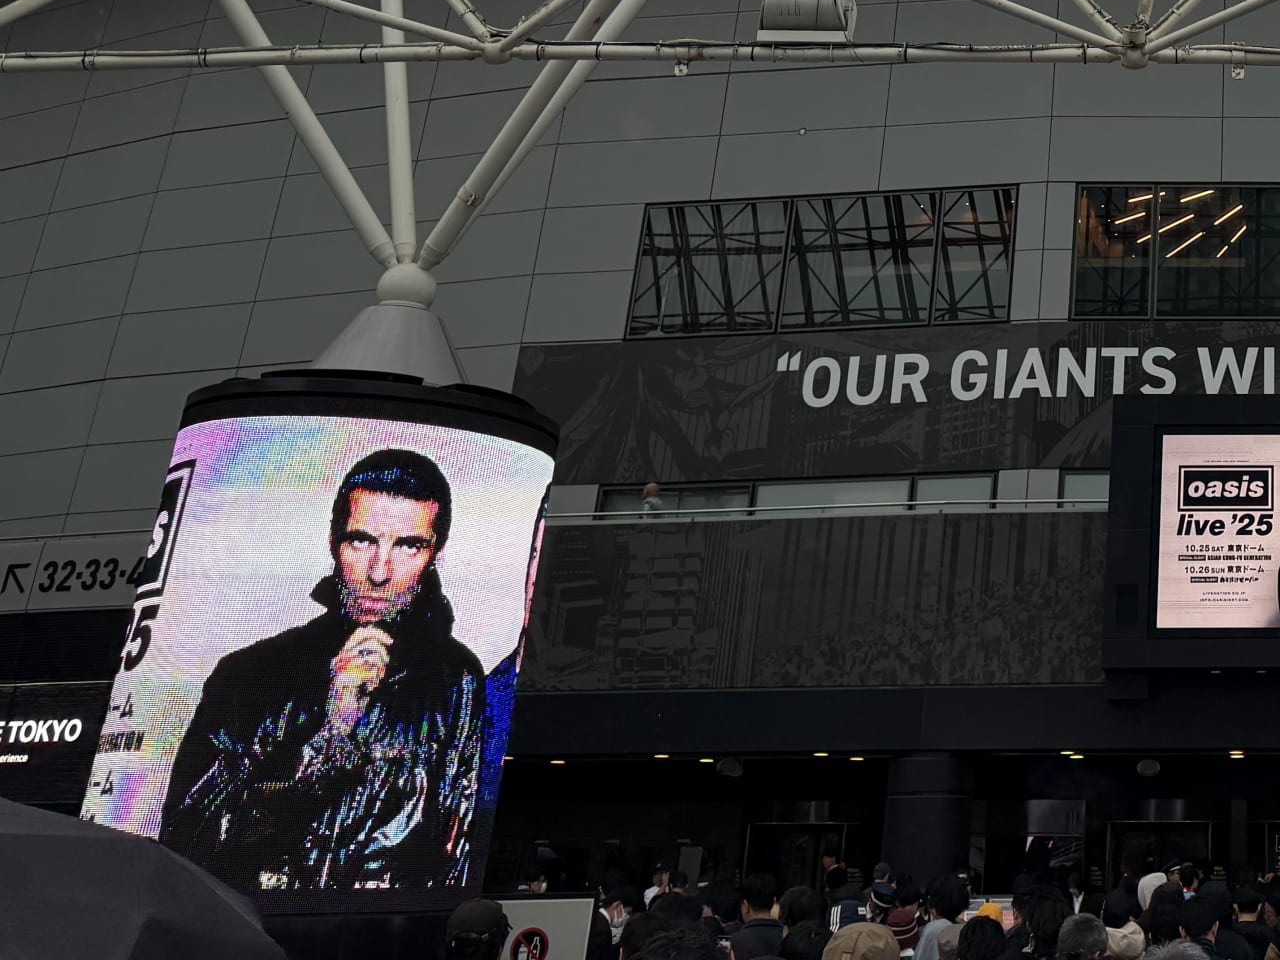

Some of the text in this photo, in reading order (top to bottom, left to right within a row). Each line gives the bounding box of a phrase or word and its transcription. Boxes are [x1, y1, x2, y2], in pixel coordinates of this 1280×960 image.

[949, 346, 1177, 400] GIANTS
[1187, 475, 1264, 498] oasis
[1176, 513, 1226, 536] live
[1185, 544, 1210, 552] 10.25
[1227, 544, 1265, 552] 東京ドーム
[1184, 566, 1210, 574] 10.26
[1226, 565, 1265, 573] 東京ドーム
[9, 718, 82, 743] TOKYO
